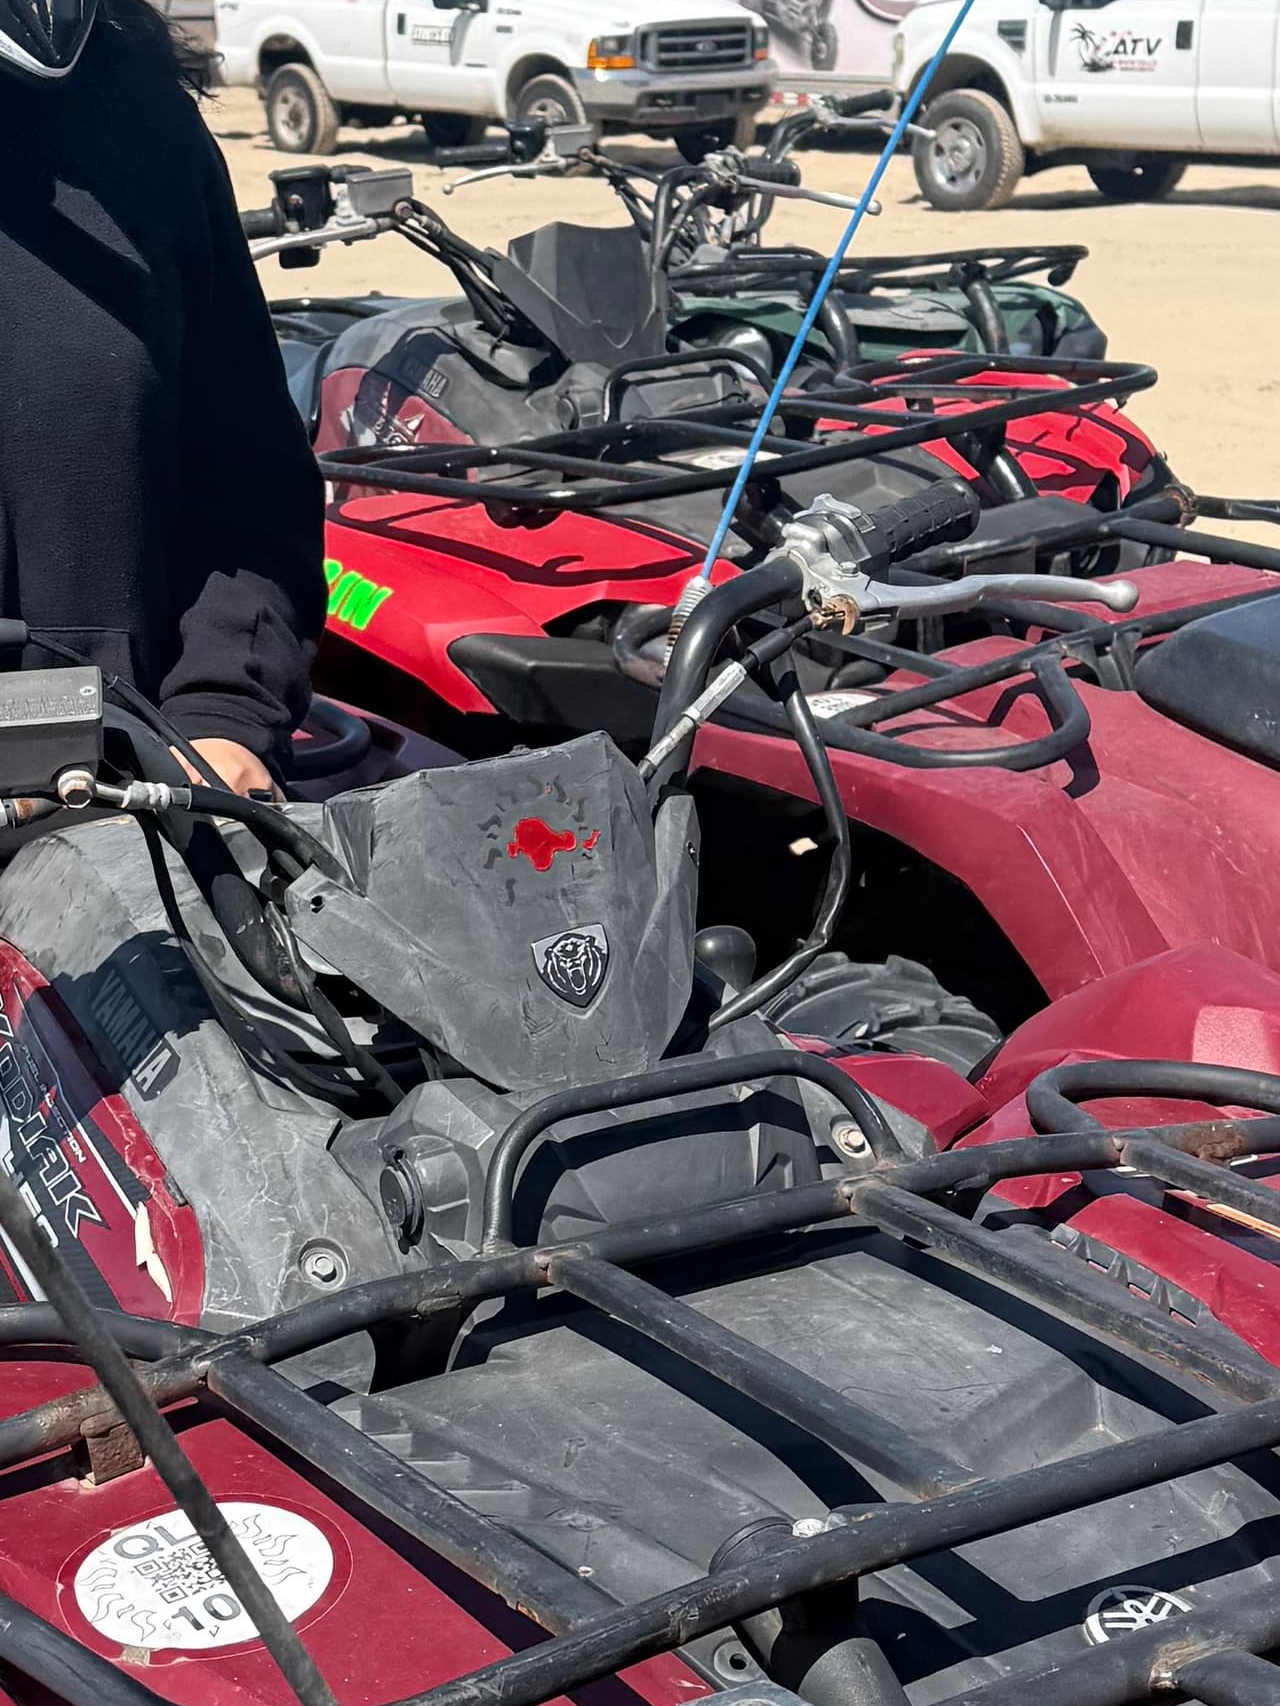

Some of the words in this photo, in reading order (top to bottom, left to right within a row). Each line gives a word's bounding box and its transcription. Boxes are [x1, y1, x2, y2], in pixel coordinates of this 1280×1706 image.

[1113, 37, 1163, 57] ATV
[90, 968, 173, 1094] YAMAHA
[20, 1044, 42, 1084] FUEL
[113, 1525, 201, 1560] QL
